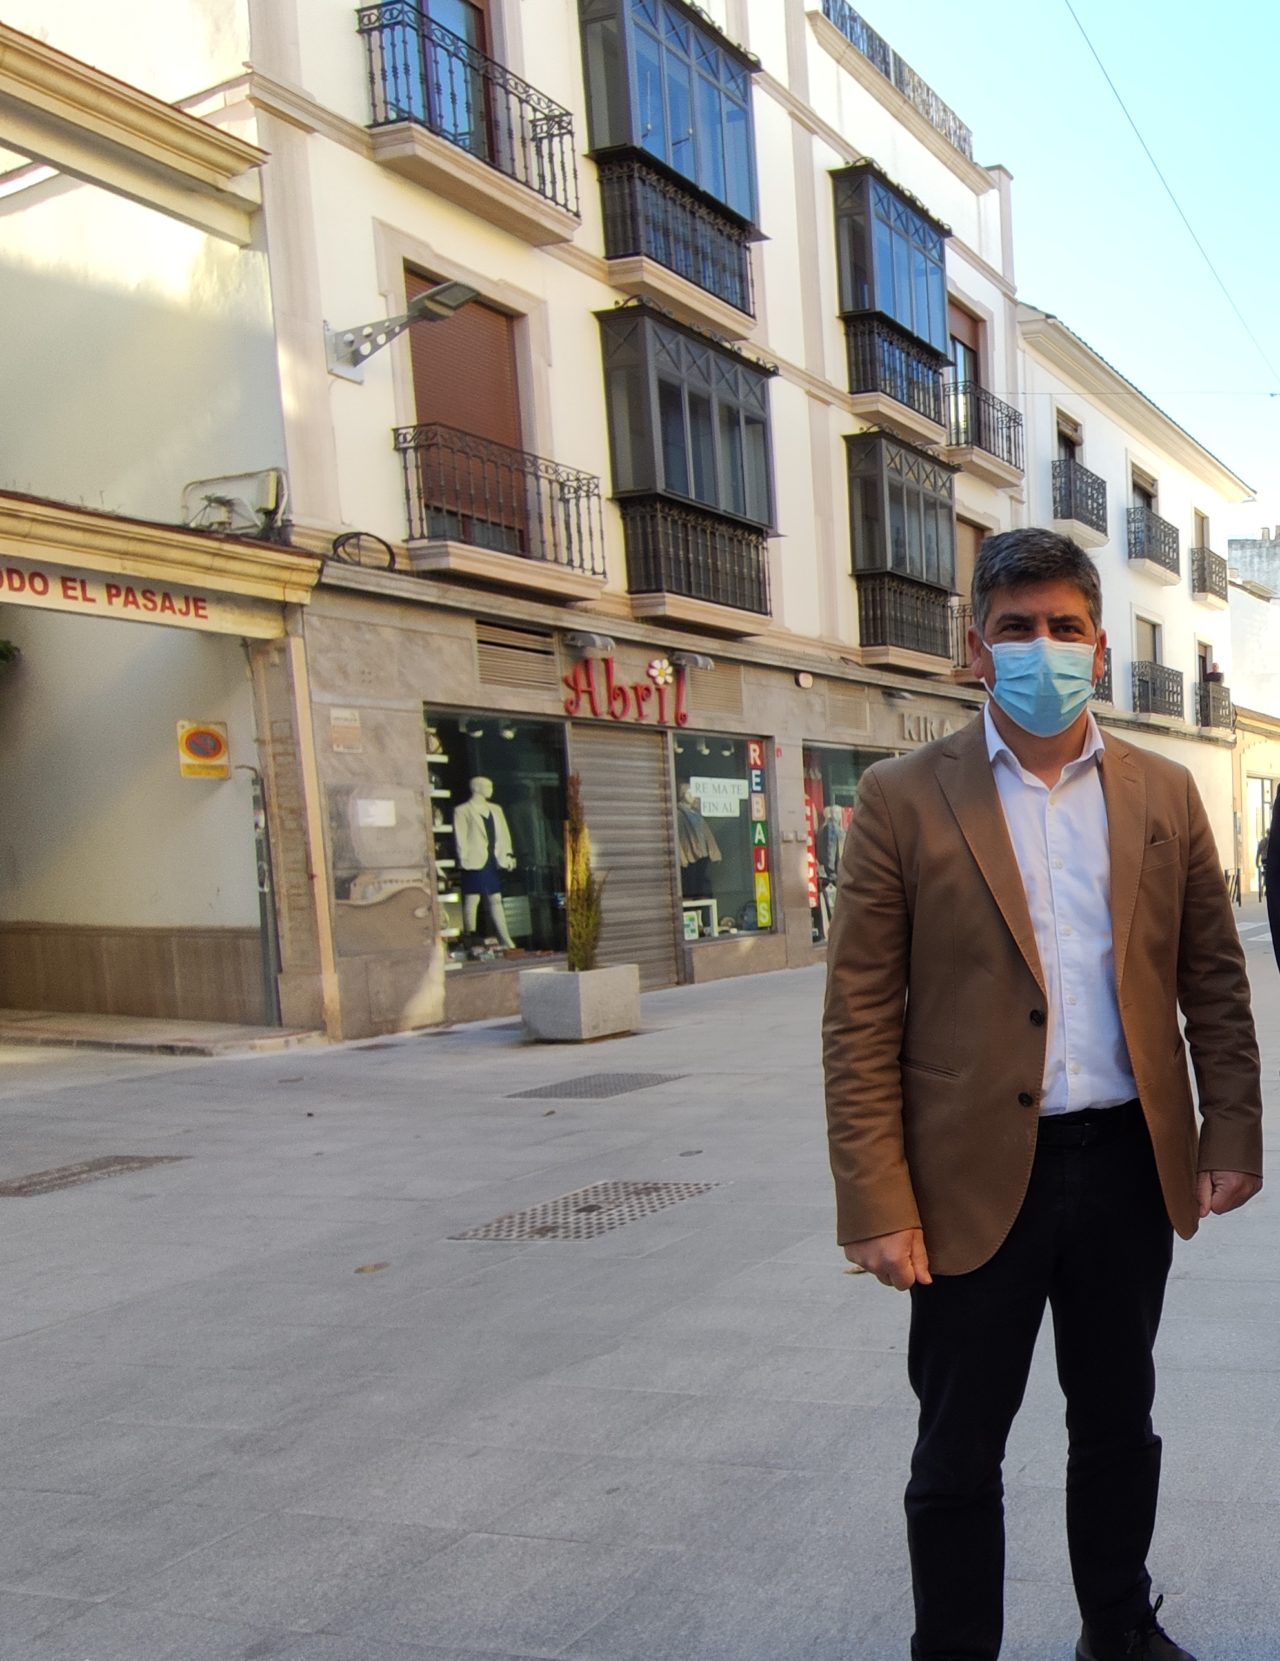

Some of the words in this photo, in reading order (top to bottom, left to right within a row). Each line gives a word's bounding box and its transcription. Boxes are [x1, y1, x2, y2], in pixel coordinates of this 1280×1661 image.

[0, 567, 49, 596] DO
[61, 576, 96, 603] EL
[105, 583, 208, 620] PASAJE
[562, 655, 688, 727] Abril
[748, 743, 770, 923] REBAJAS
